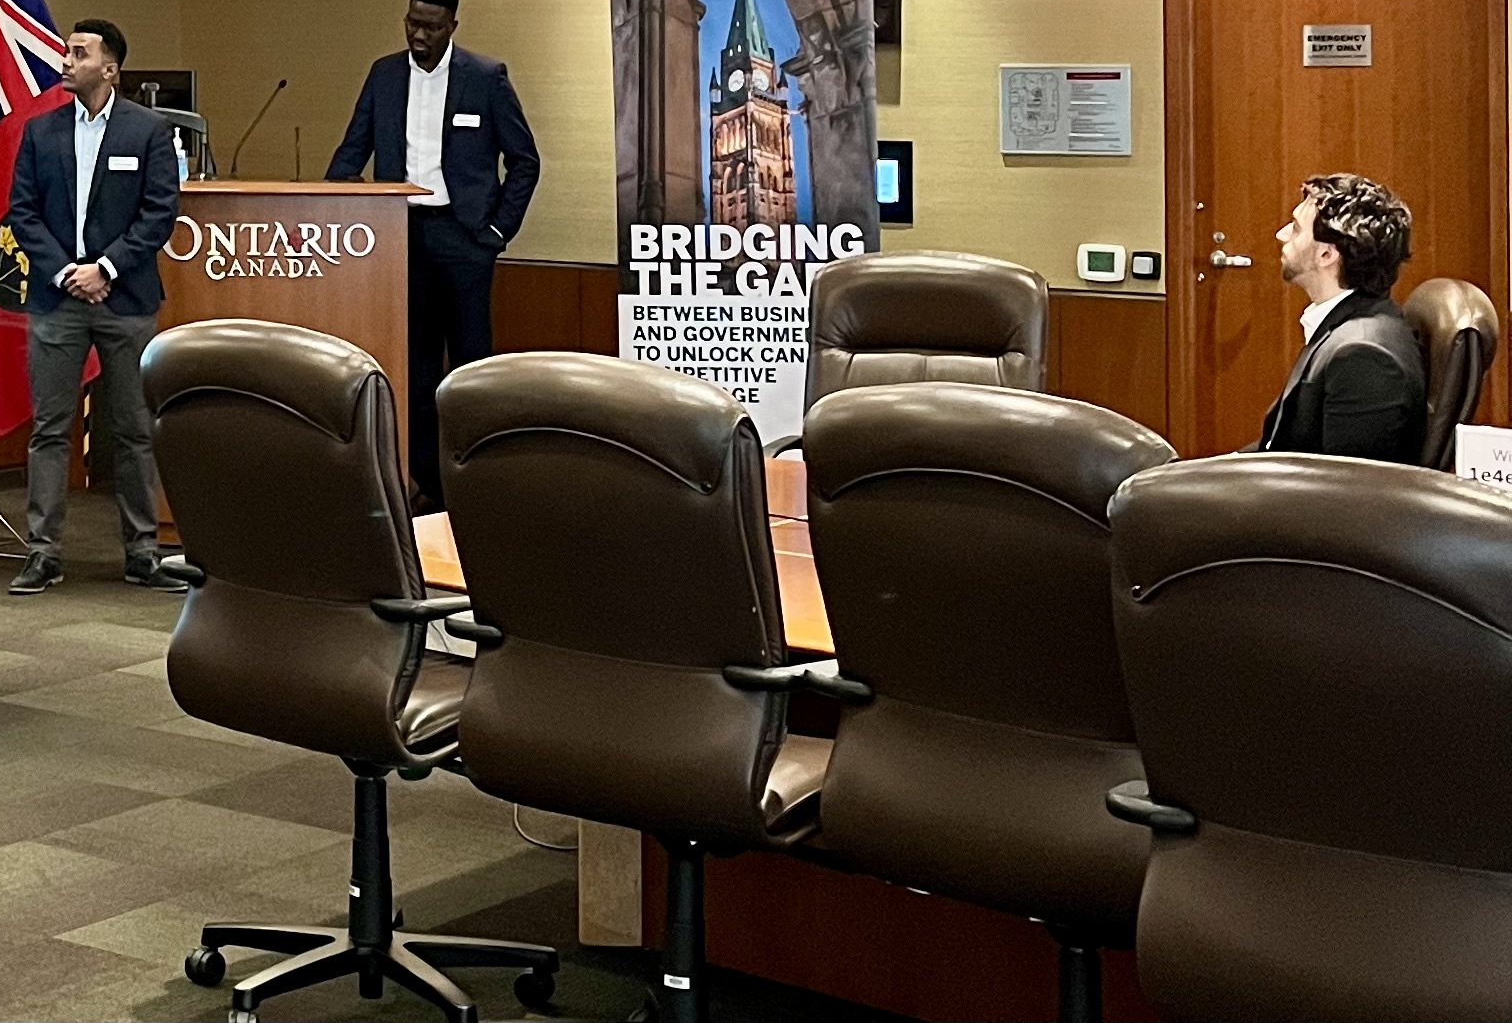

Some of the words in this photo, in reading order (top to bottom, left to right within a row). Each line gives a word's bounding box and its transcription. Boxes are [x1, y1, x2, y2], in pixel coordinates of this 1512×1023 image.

[1307, 34, 1367, 42] EMERGENCY
[1312, 44, 1334, 52] EXIT
[1336, 44, 1362, 52] ONLY
[162, 216, 376, 265] ONTARIO
[630, 224, 865, 260] BRIDGING
[205, 256, 324, 281] CANADA
[629, 262, 723, 297] THE
[633, 306, 734, 322] BETWEEN
[633, 326, 677, 341] AND
[633, 346, 661, 361] TO
[667, 346, 755, 363] UNLOCK
